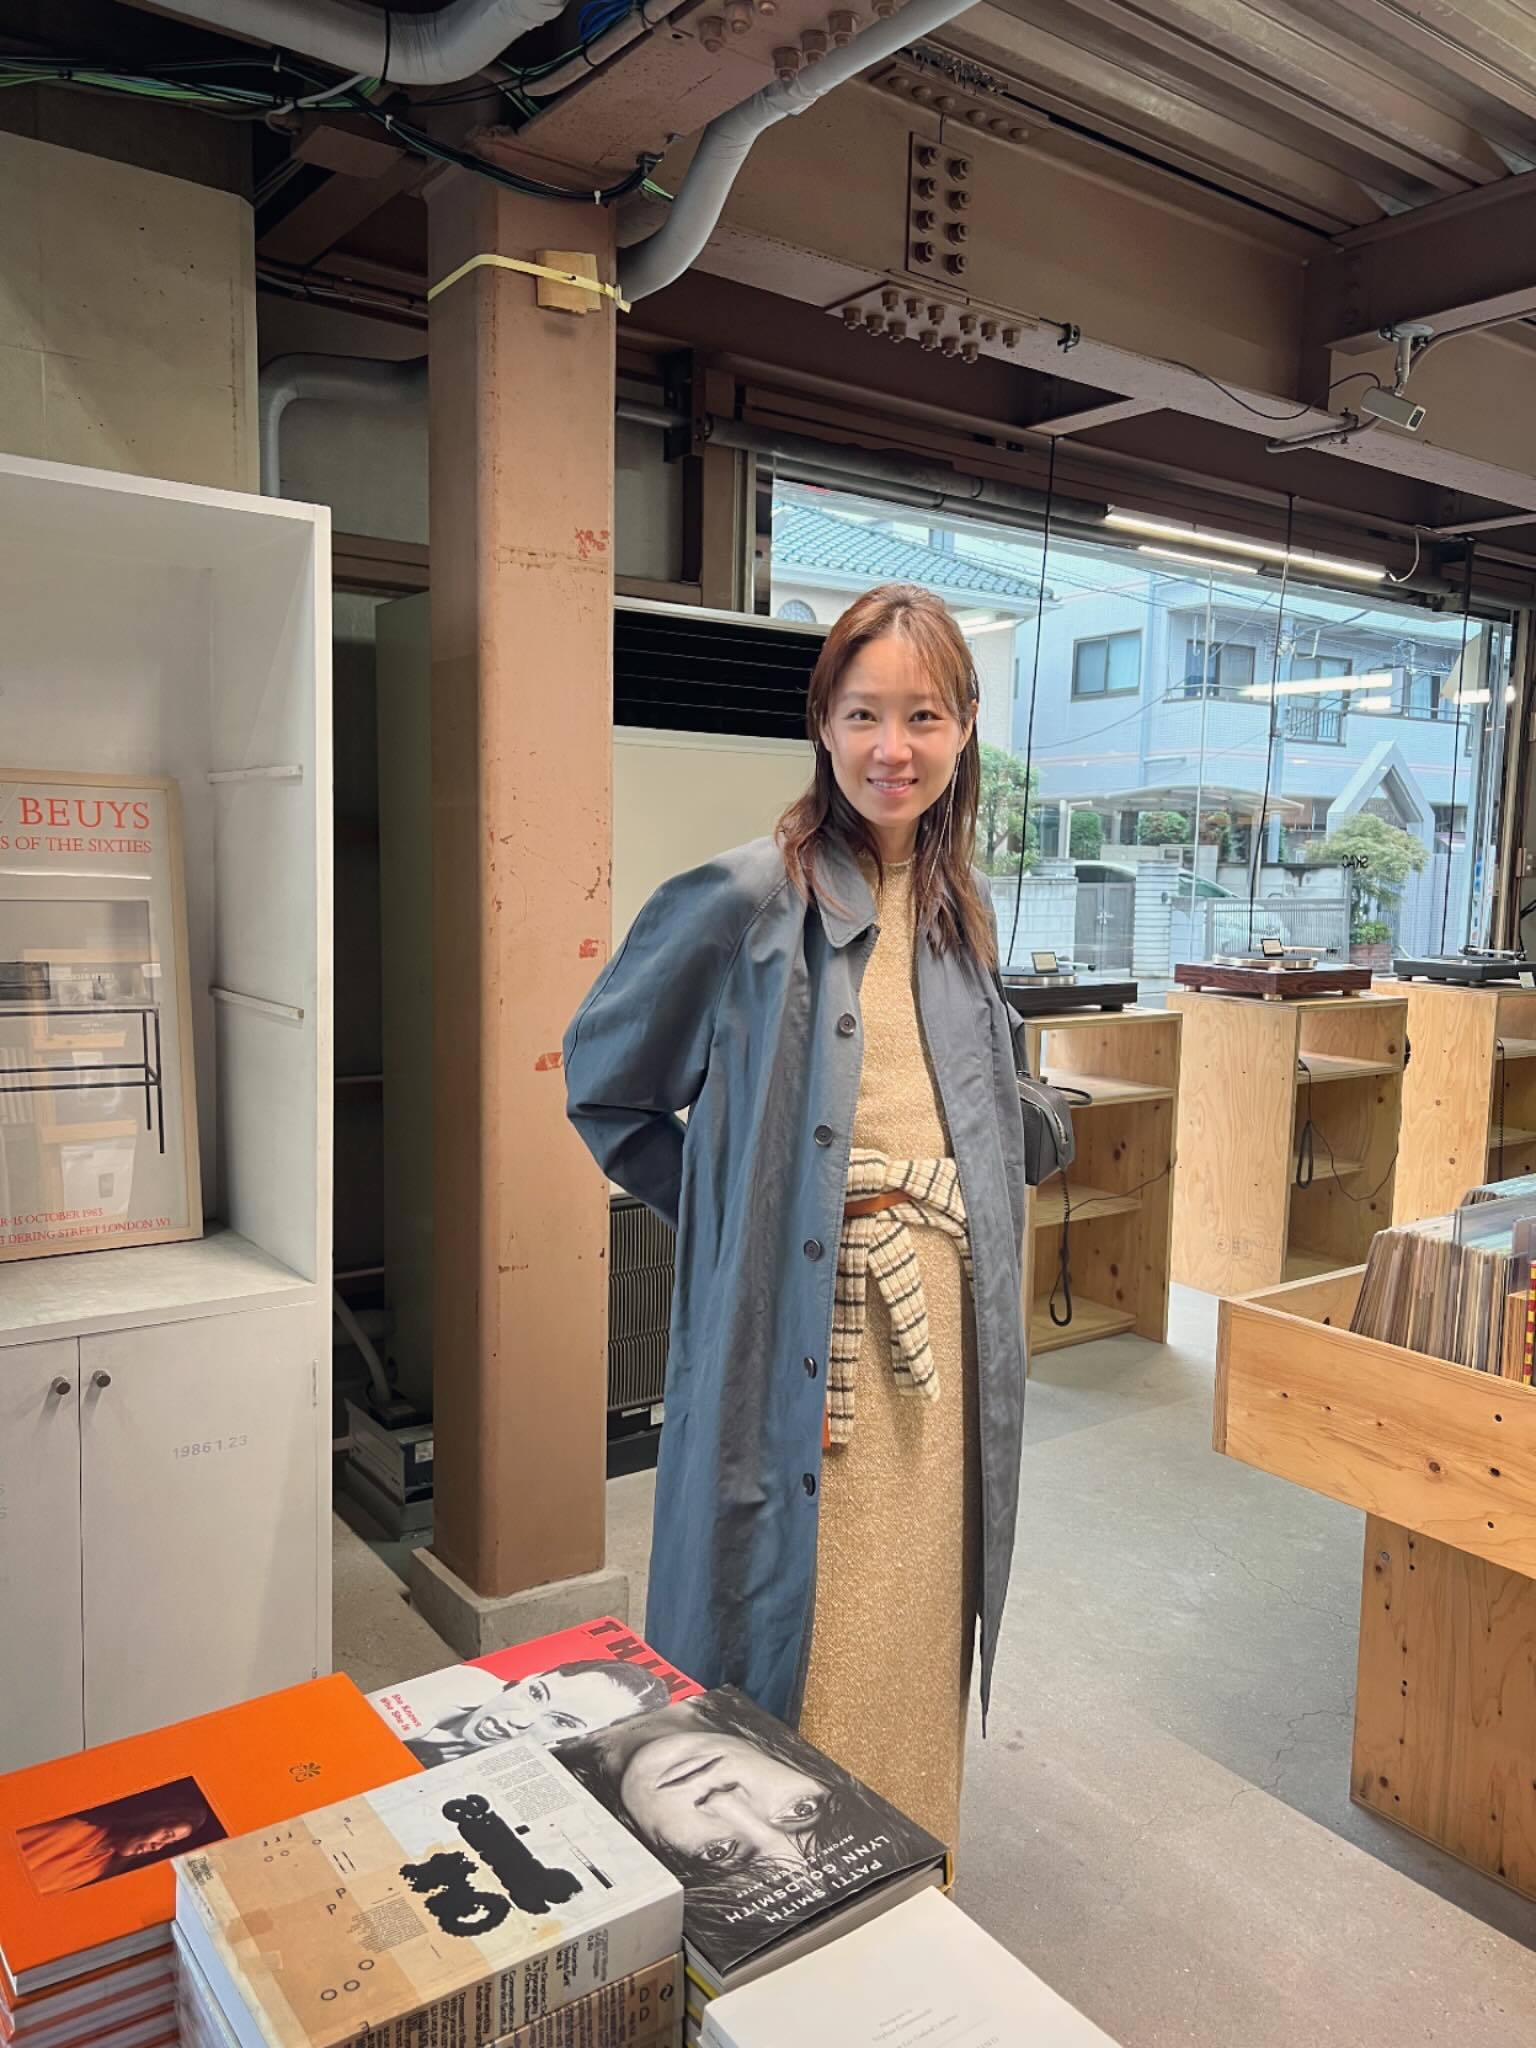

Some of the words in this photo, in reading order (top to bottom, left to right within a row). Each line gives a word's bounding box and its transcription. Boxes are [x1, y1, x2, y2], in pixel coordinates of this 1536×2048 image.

[17, 796, 150, 830] BEUYS
[15, 836, 42, 850] OF
[45, 837, 85, 852] THE
[88, 838, 153, 854] SIXTIES
[24, 1209, 81, 1224] OCTOBER
[101, 1218, 154, 1234] LONDON
[841, 1834, 891, 1865] LYNN
[831, 1858, 883, 1890] PATTI
[725, 1863, 837, 1924] GOLDSMITH
[764, 1887, 827, 1924] SMITH
